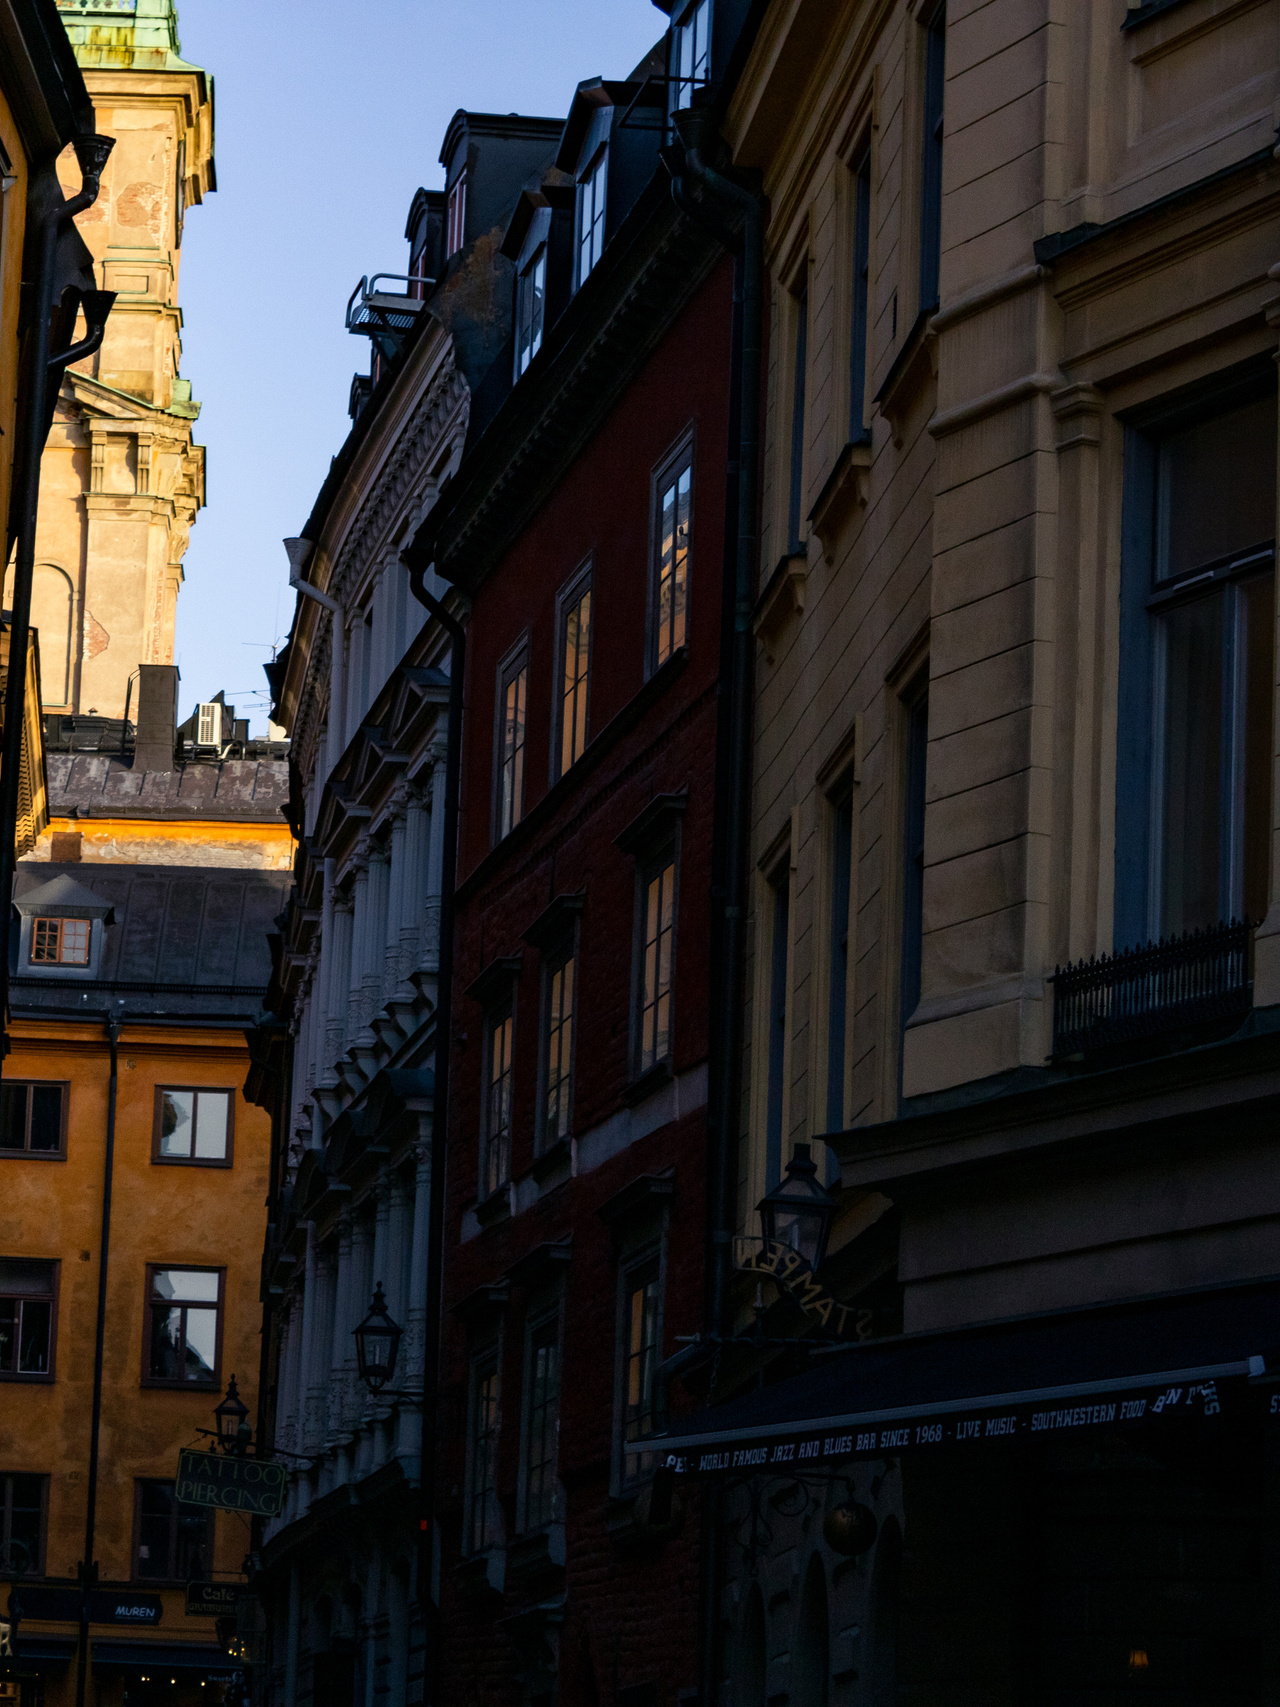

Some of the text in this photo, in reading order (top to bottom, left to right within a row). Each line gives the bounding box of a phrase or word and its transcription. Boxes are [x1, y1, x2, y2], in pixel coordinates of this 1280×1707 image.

[699, 1452, 729, 1471] WORLD
[732, 1447, 768, 1467] FAMOUS
[770, 1443, 795, 1463] JAZZ
[798, 1440, 820, 1459] AND
[823, 1436, 853, 1455] BLUES
[856, 1432, 877, 1451] BAR
[880, 1428, 911, 1449] SINCE
[915, 1424, 943, 1444] 1968
[956, 1420, 982, 1440] LIVE
[985, 1415, 1018, 1437] MUSIC
[1030, 1403, 1117, 1432] SOUTHWESTERN
[1119, 1399, 1147, 1420] FOOD
[184, 1454, 281, 1486] TATTOO
[180, 1480, 278, 1513] PIERCING
[202, 1586, 235, 1601] Café
